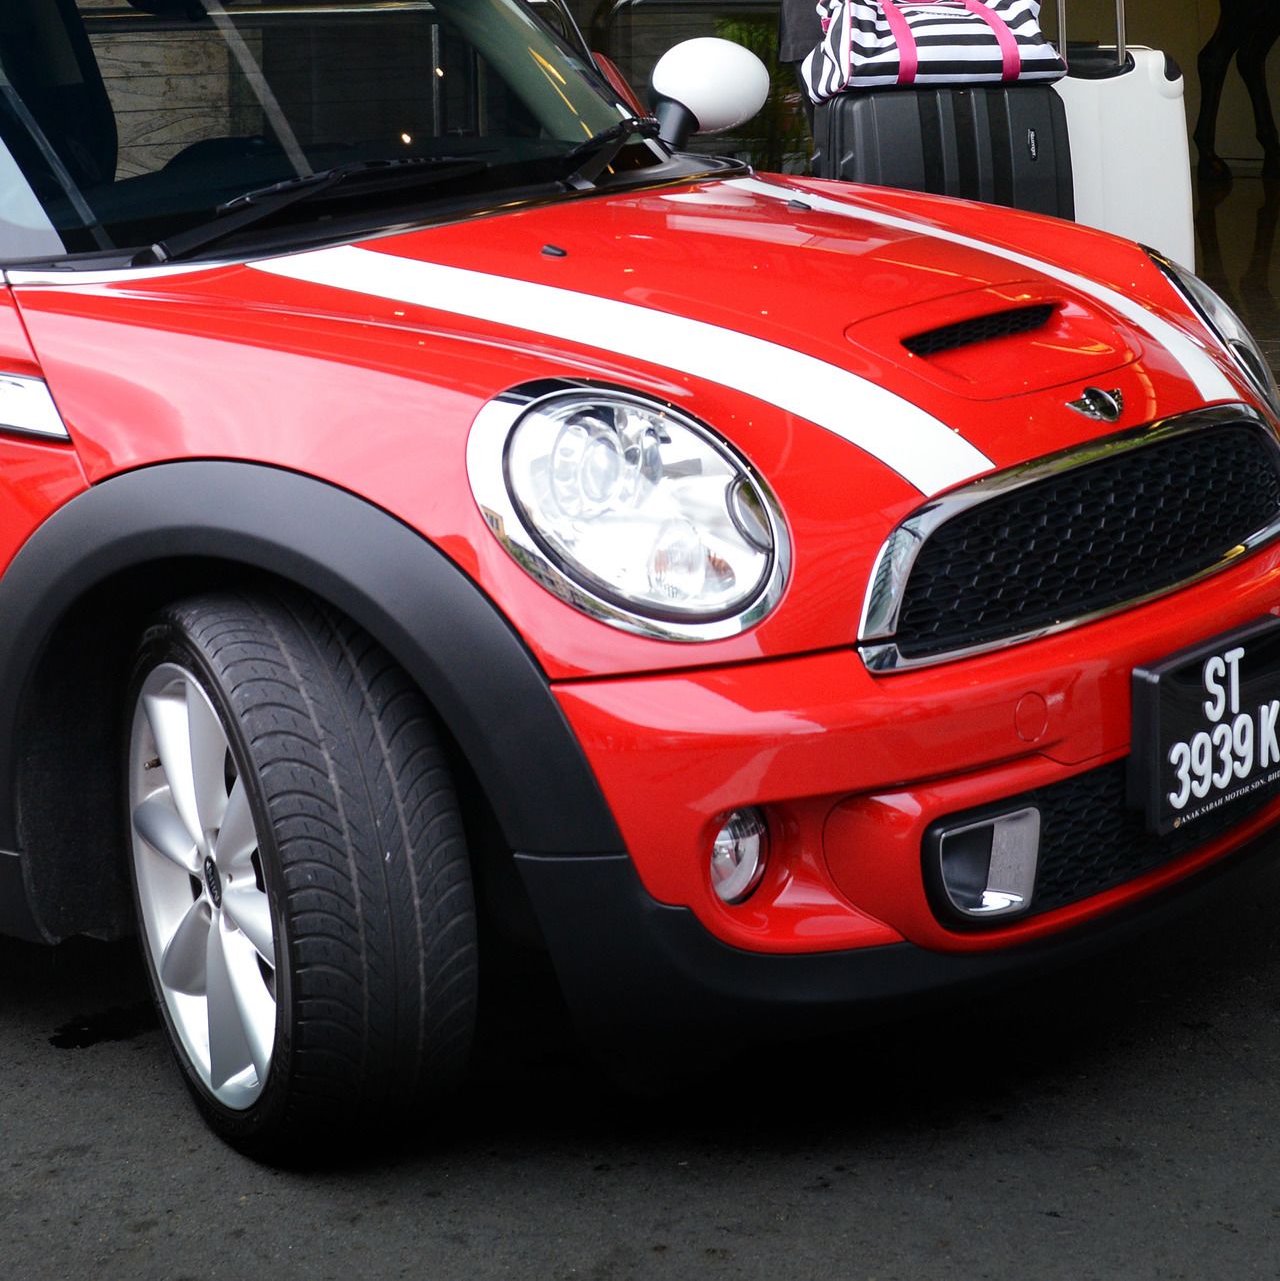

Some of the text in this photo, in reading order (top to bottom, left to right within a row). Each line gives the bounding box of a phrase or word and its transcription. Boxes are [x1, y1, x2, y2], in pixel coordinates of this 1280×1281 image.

[1204, 646, 1245, 722] ST
[1169, 700, 1280, 809] 3939 K
[1181, 809, 1201, 823] ANAK
[1201, 798, 1223, 816] SABAH
[1224, 786, 1250, 805] MOTOR
